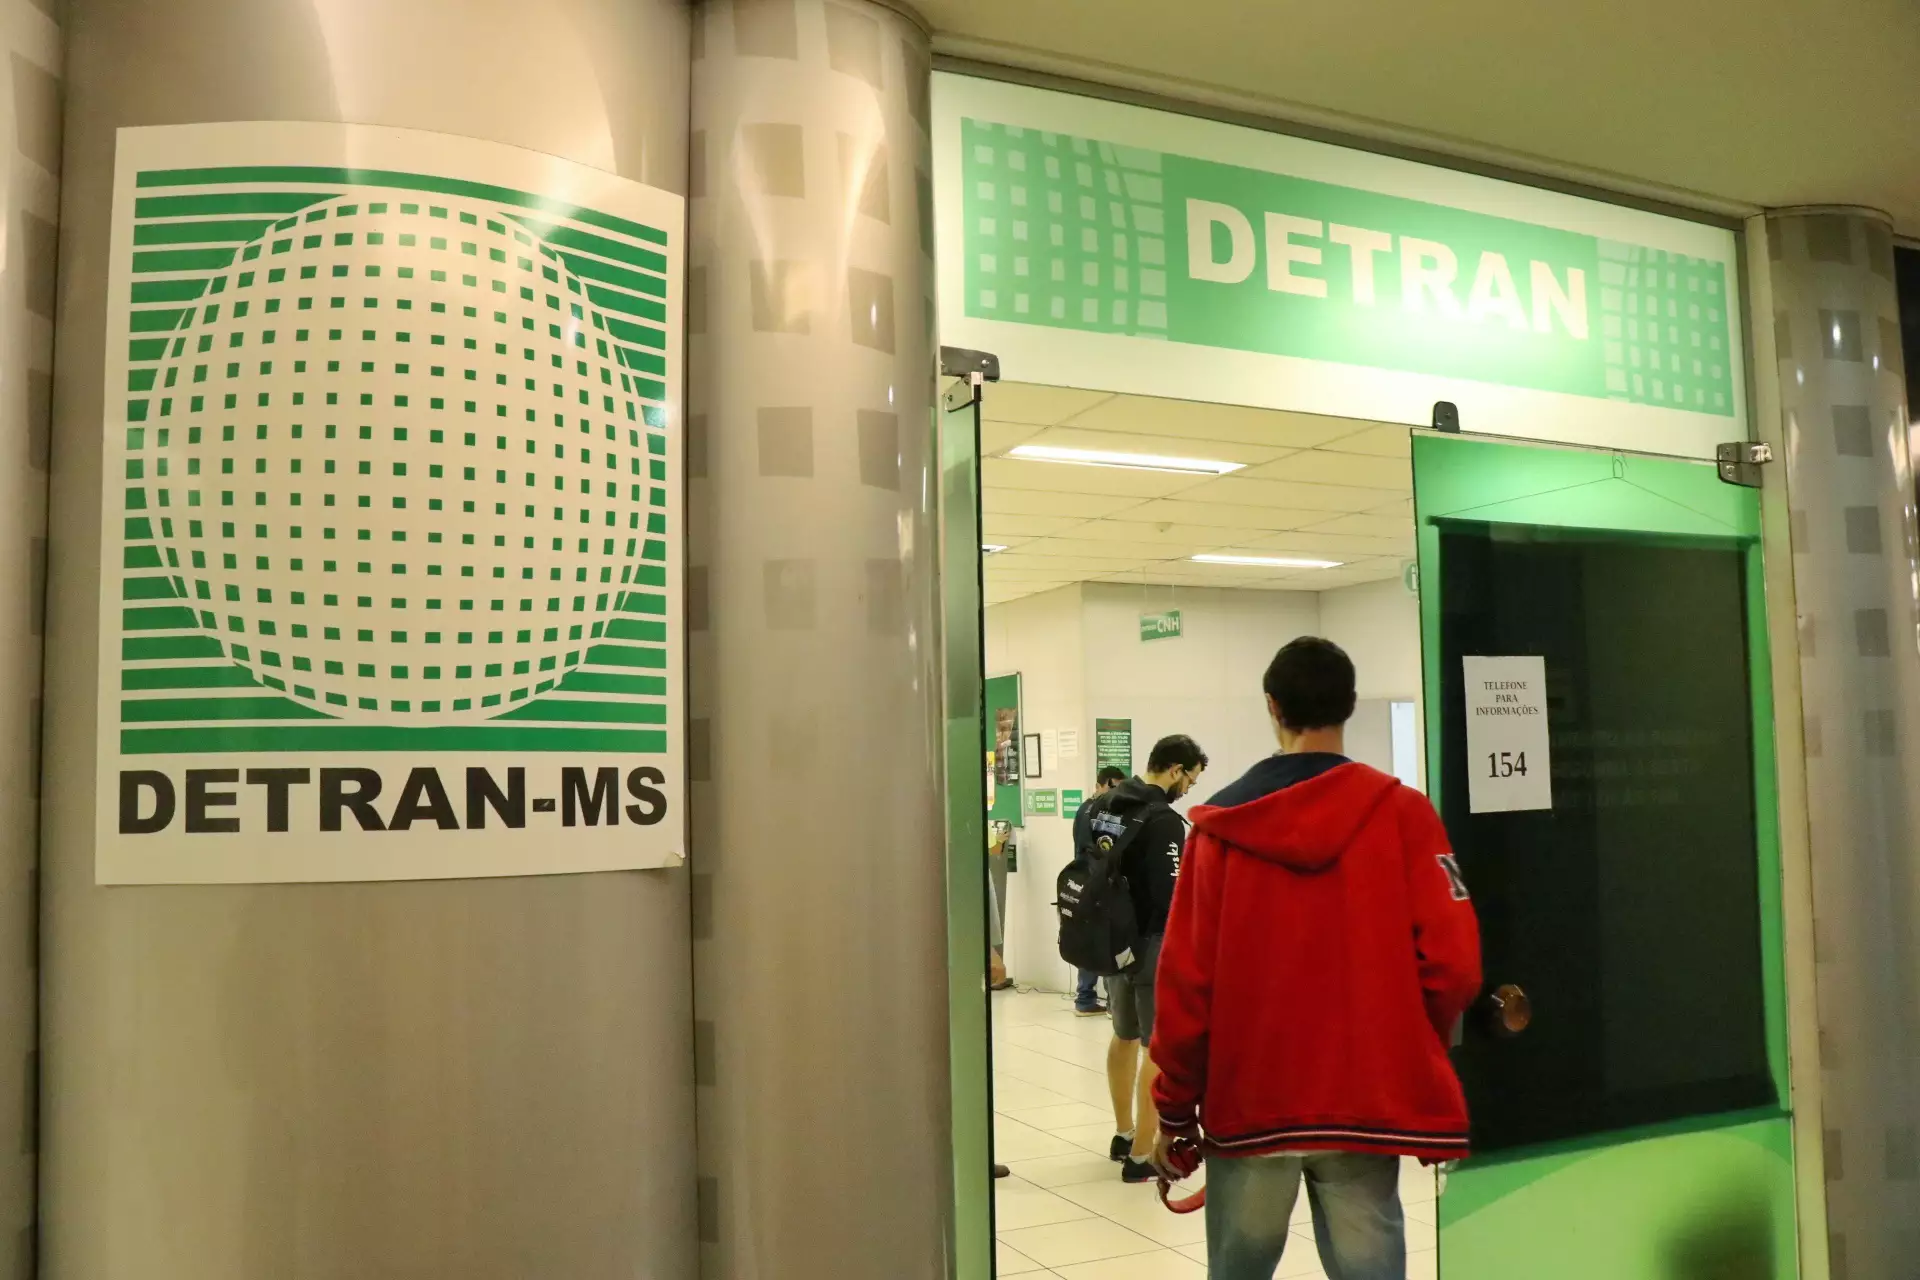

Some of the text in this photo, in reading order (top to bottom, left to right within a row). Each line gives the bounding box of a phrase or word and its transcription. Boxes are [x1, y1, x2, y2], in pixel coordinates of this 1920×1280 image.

[1186, 198, 1589, 340] DETRAN
[1157, 616, 1180, 633] CNH
[1484, 681, 1528, 690] TELEFONE
[1495, 694, 1518, 703] PARA
[1476, 705, 1539, 717] INFORMAÇÕES
[1488, 751, 1527, 778] 154
[118, 766, 668, 835] DETRAN-MS
